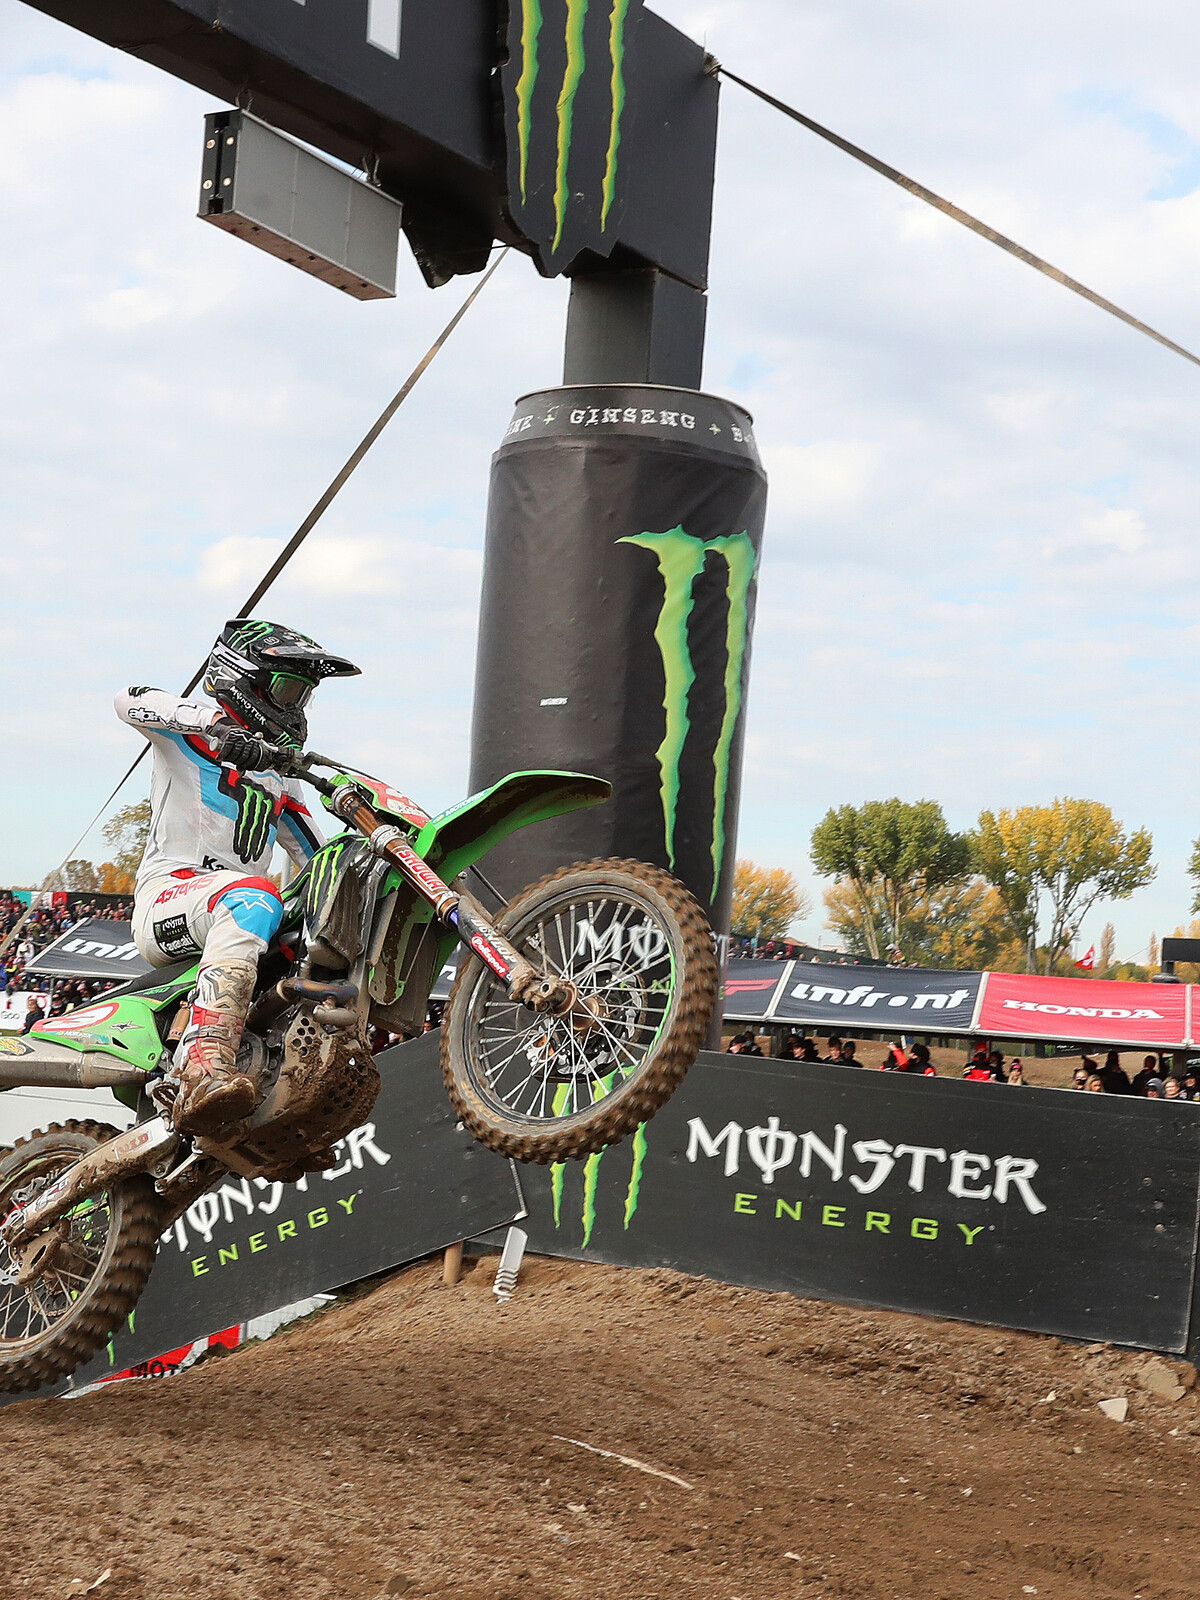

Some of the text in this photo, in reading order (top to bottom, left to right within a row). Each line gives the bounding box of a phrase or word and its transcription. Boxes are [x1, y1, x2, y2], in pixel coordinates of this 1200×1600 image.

[570, 406, 697, 431] GINSENG
[395, 849, 450, 892] SHOWA
[471, 936, 507, 974] Polisport
[1003, 999, 1165, 1019] HONDA
[685, 1116, 1048, 1215] MONSTER
[191, 1193, 357, 1278] ENERGY
[734, 1192, 985, 1247] ENERGY
